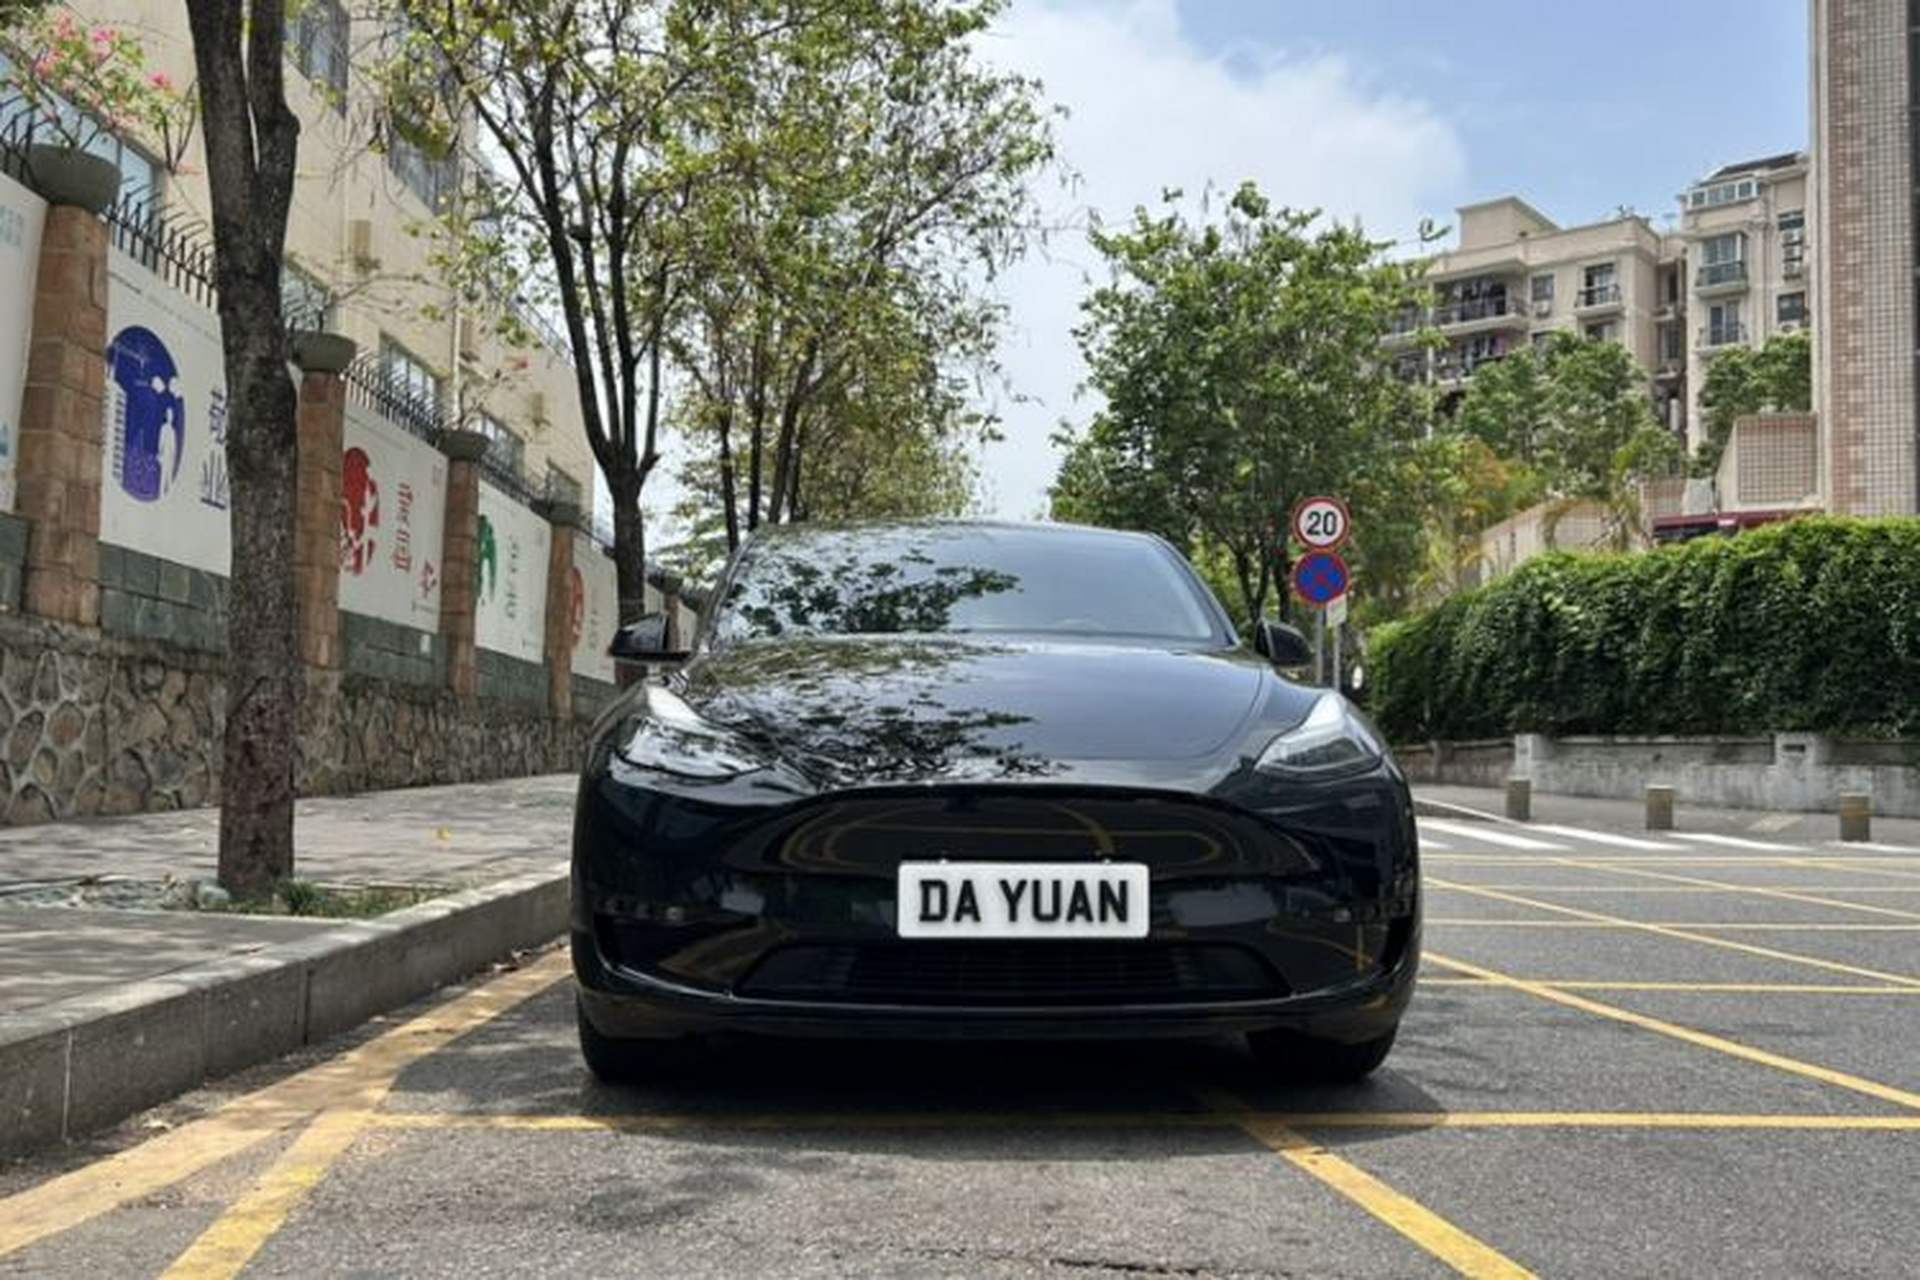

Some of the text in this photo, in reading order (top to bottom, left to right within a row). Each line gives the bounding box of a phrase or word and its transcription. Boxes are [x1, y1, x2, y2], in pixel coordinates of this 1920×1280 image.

[1307, 511, 1337, 536] 20
[919, 879, 1129, 923] DA YUAN
